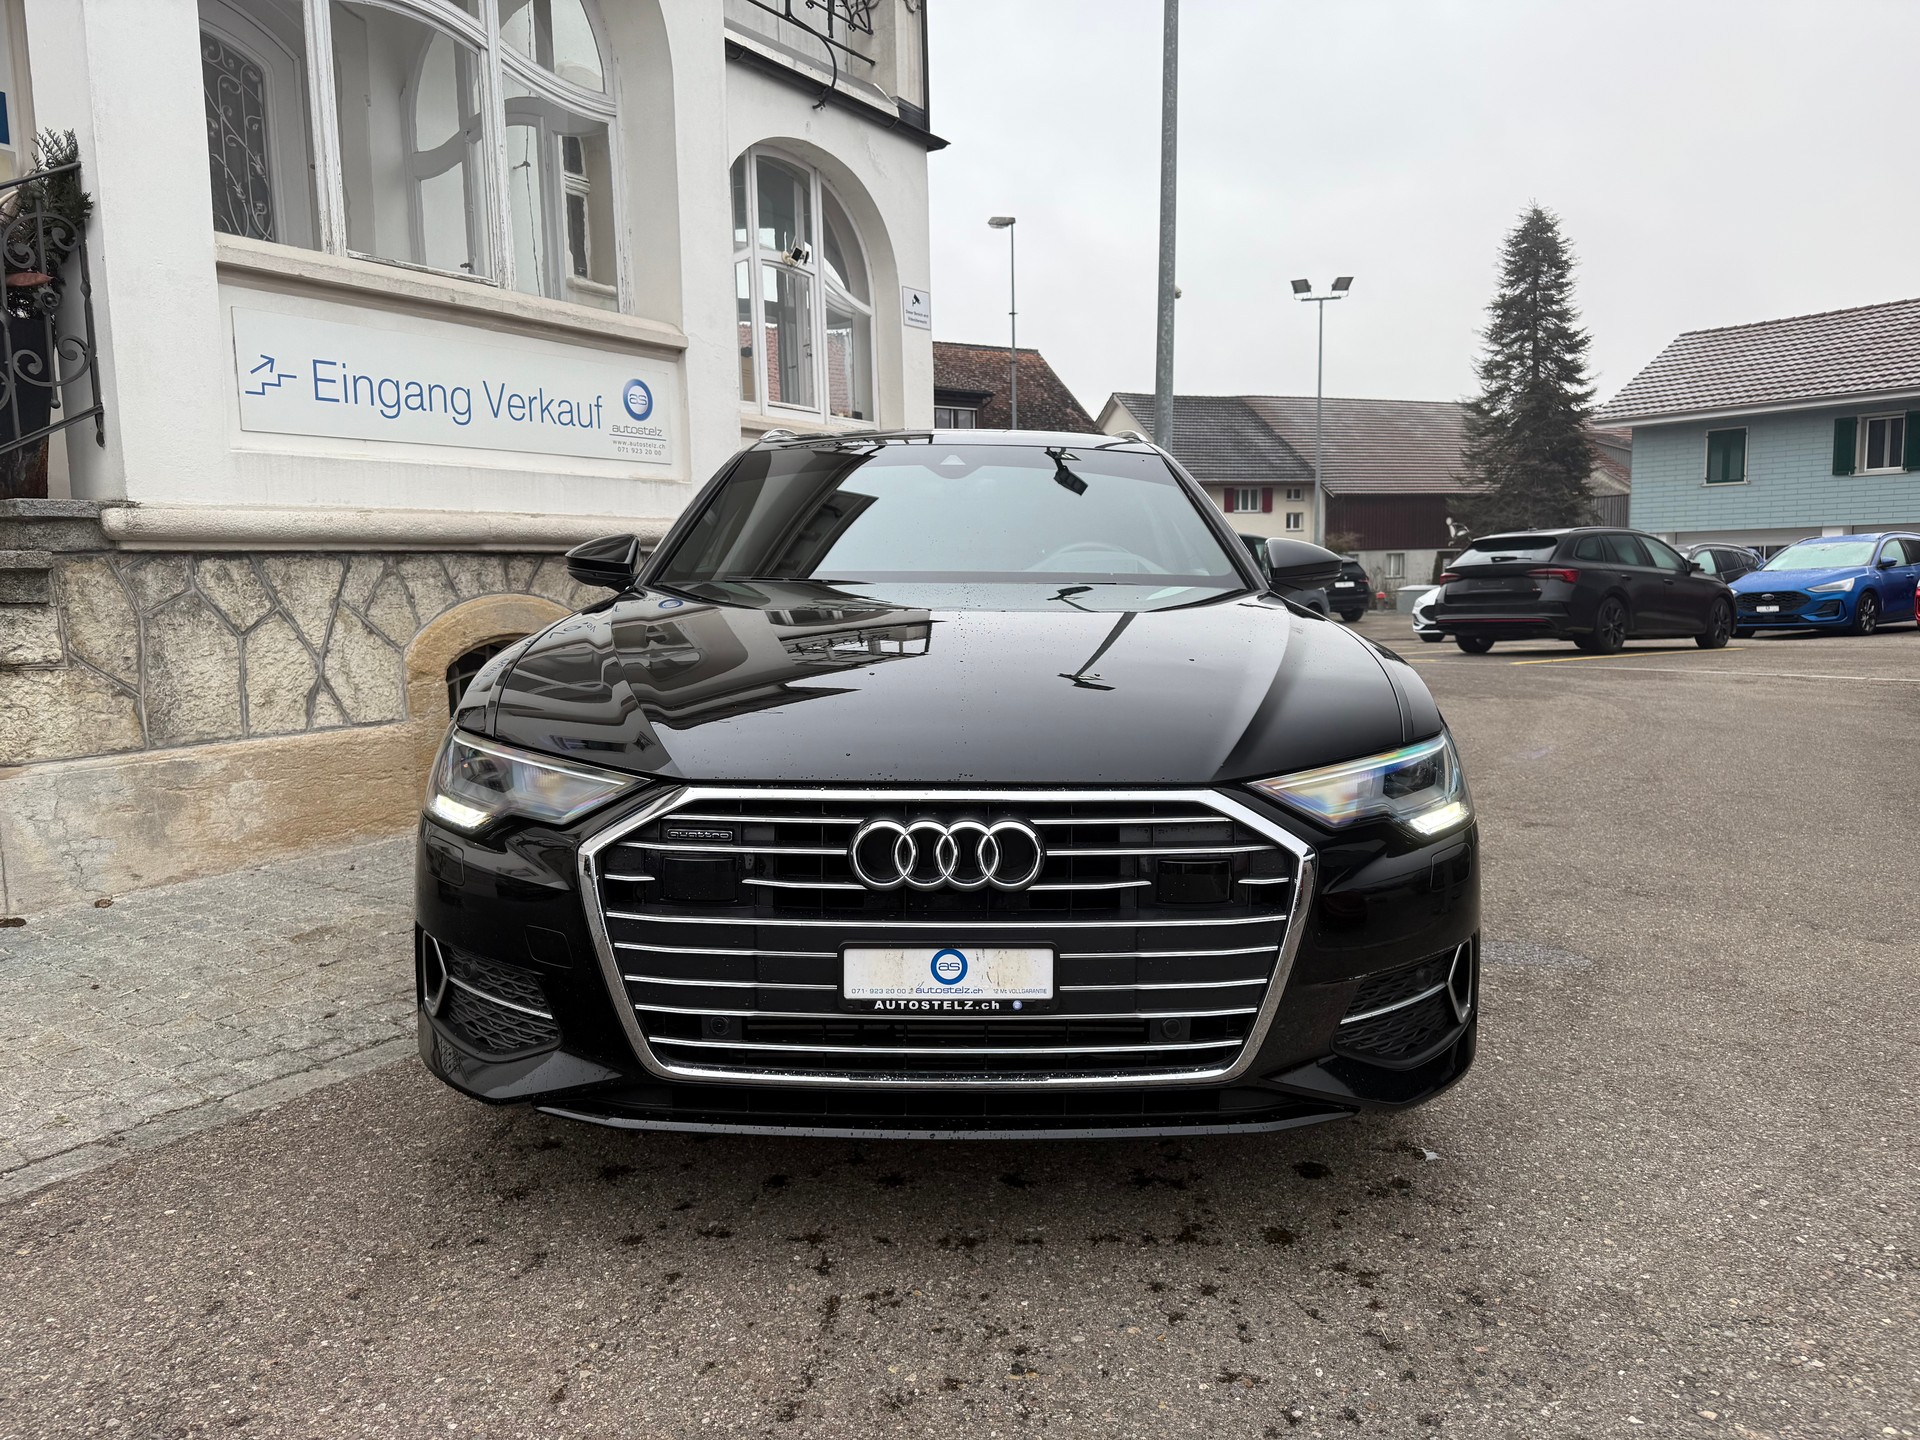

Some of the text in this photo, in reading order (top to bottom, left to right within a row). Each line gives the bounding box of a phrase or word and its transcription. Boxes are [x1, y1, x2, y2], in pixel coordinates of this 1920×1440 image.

[312, 358, 603, 429] Eingang Verkauf
[612, 424, 663, 437] autostelz
[612, 440, 666, 449] www.autostelz.ch
[670, 831, 729, 839] quattro
[938, 962, 961, 971] as
[915, 985, 984, 994] autostelz.ch
[874, 1000, 1000, 1010] AUTOSTELZ.ch
